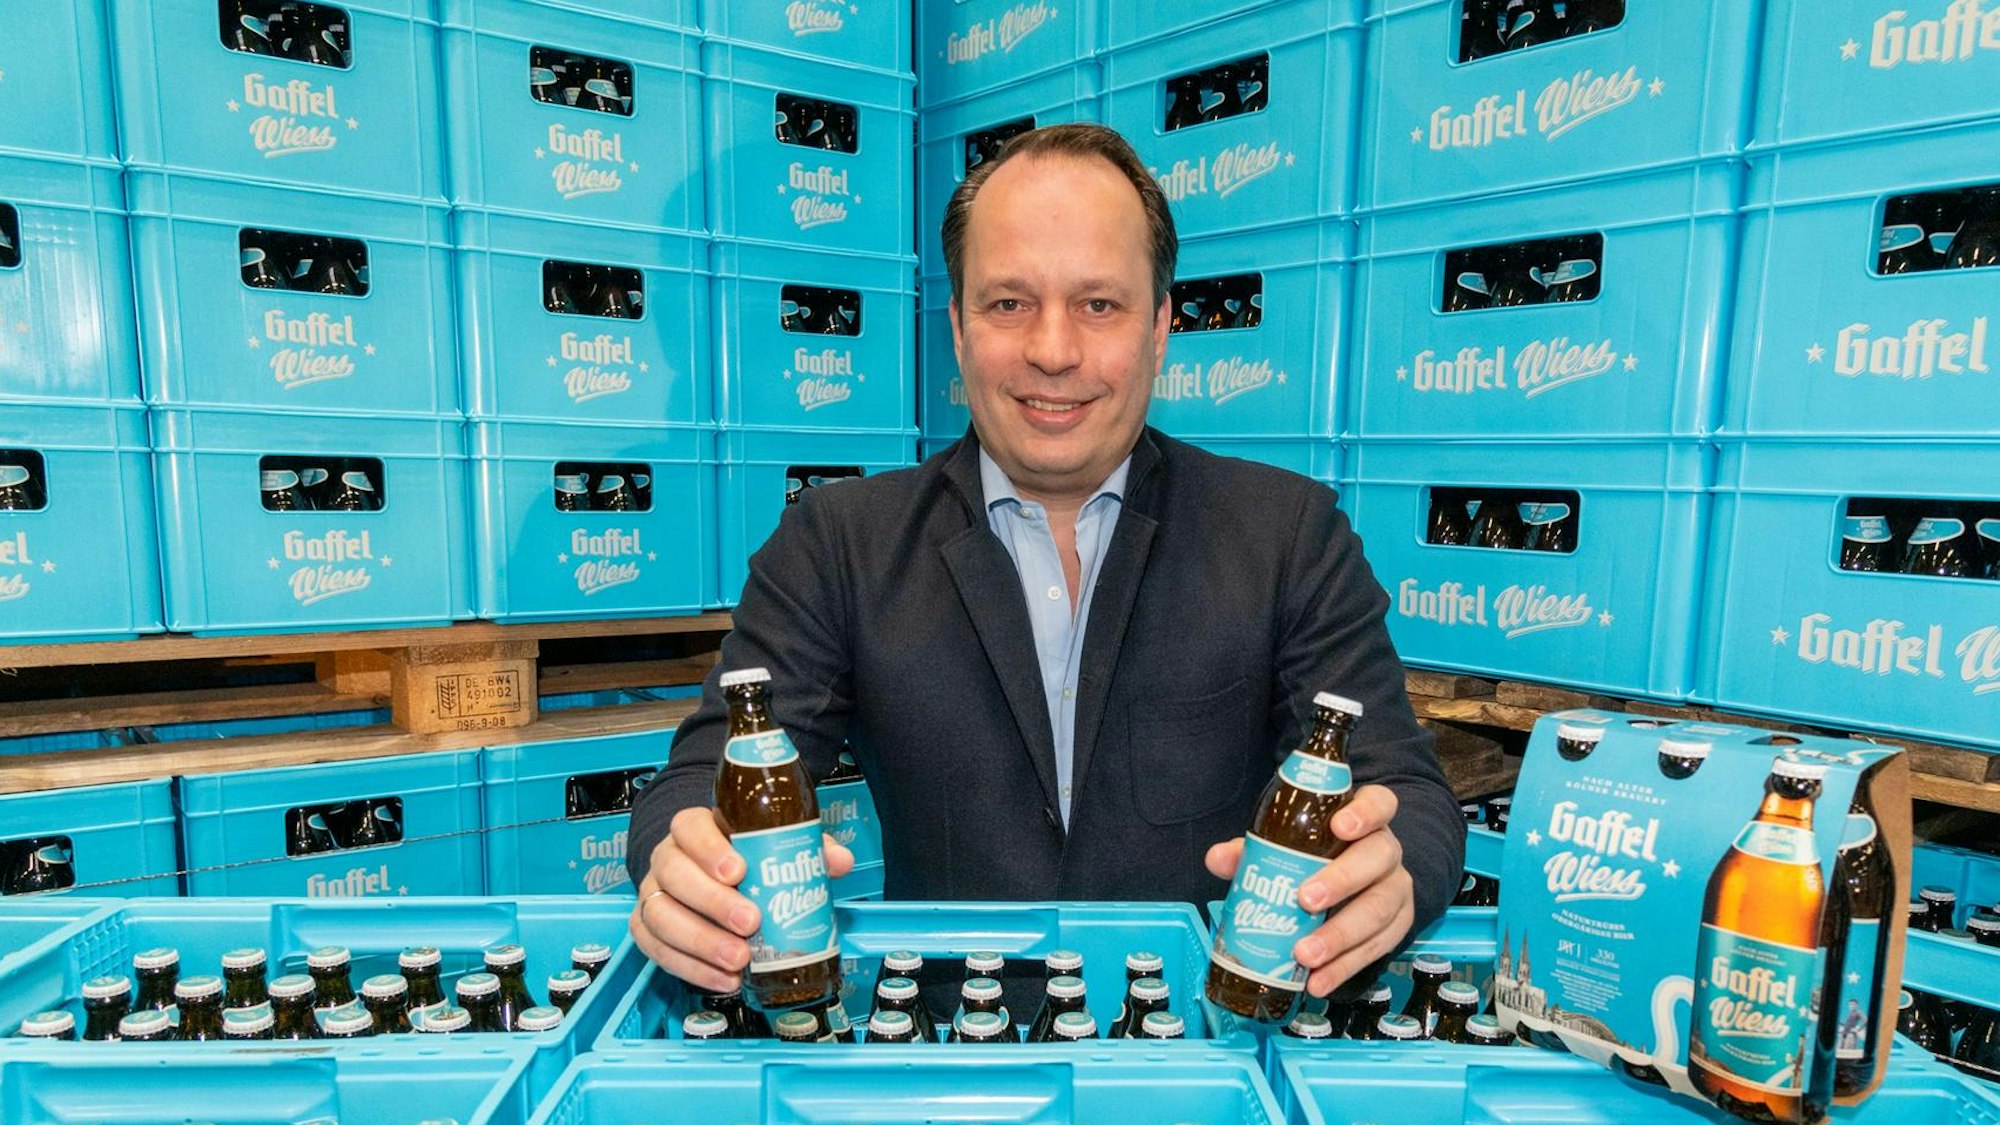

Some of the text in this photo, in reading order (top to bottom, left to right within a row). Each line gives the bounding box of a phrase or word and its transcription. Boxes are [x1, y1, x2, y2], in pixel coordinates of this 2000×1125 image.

[948, 20, 996, 64] Gaffel
[244, 73, 338, 119] Gaffel
[1428, 66, 1641, 151] Gaffel Wiess
[249, 113, 337, 158] Wiess
[549, 123, 622, 163] Gaffel
[552, 160, 622, 199] Wiess
[789, 162, 849, 197] Gaffel
[1211, 140, 1281, 198] Wiess
[791, 195, 848, 229] Wiess
[265, 309, 354, 347] Gaffel
[561, 332, 633, 364] Gaffel
[1834, 317, 1989, 379] Gaffel
[270, 346, 355, 390] Wiess
[563, 364, 631, 403] Wiess
[795, 348, 853, 378] Gaffel
[1153, 346, 1273, 405] affel Wiess
[1413, 337, 1617, 398] Gaffel Wiess
[796, 377, 851, 411] Wiess
[283, 530, 372, 563] Gaffel
[572, 528, 641, 557] Gaffel
[289, 561, 371, 605] Wiess
[574, 559, 640, 595] Wiess
[1399, 578, 1593, 638] Gaffel Wiess
[1798, 612, 1945, 679] Gaffel
[581, 830, 628, 860] Gaff
[1549, 800, 1660, 862] Gaffel
[760, 848, 827, 887] Gaffel
[1242, 864, 1298, 908] Gaffe
[1544, 851, 1647, 903] Wiess
[1711, 956, 1796, 1008] Gaffel
[1709, 996, 1790, 1038] Wiess
